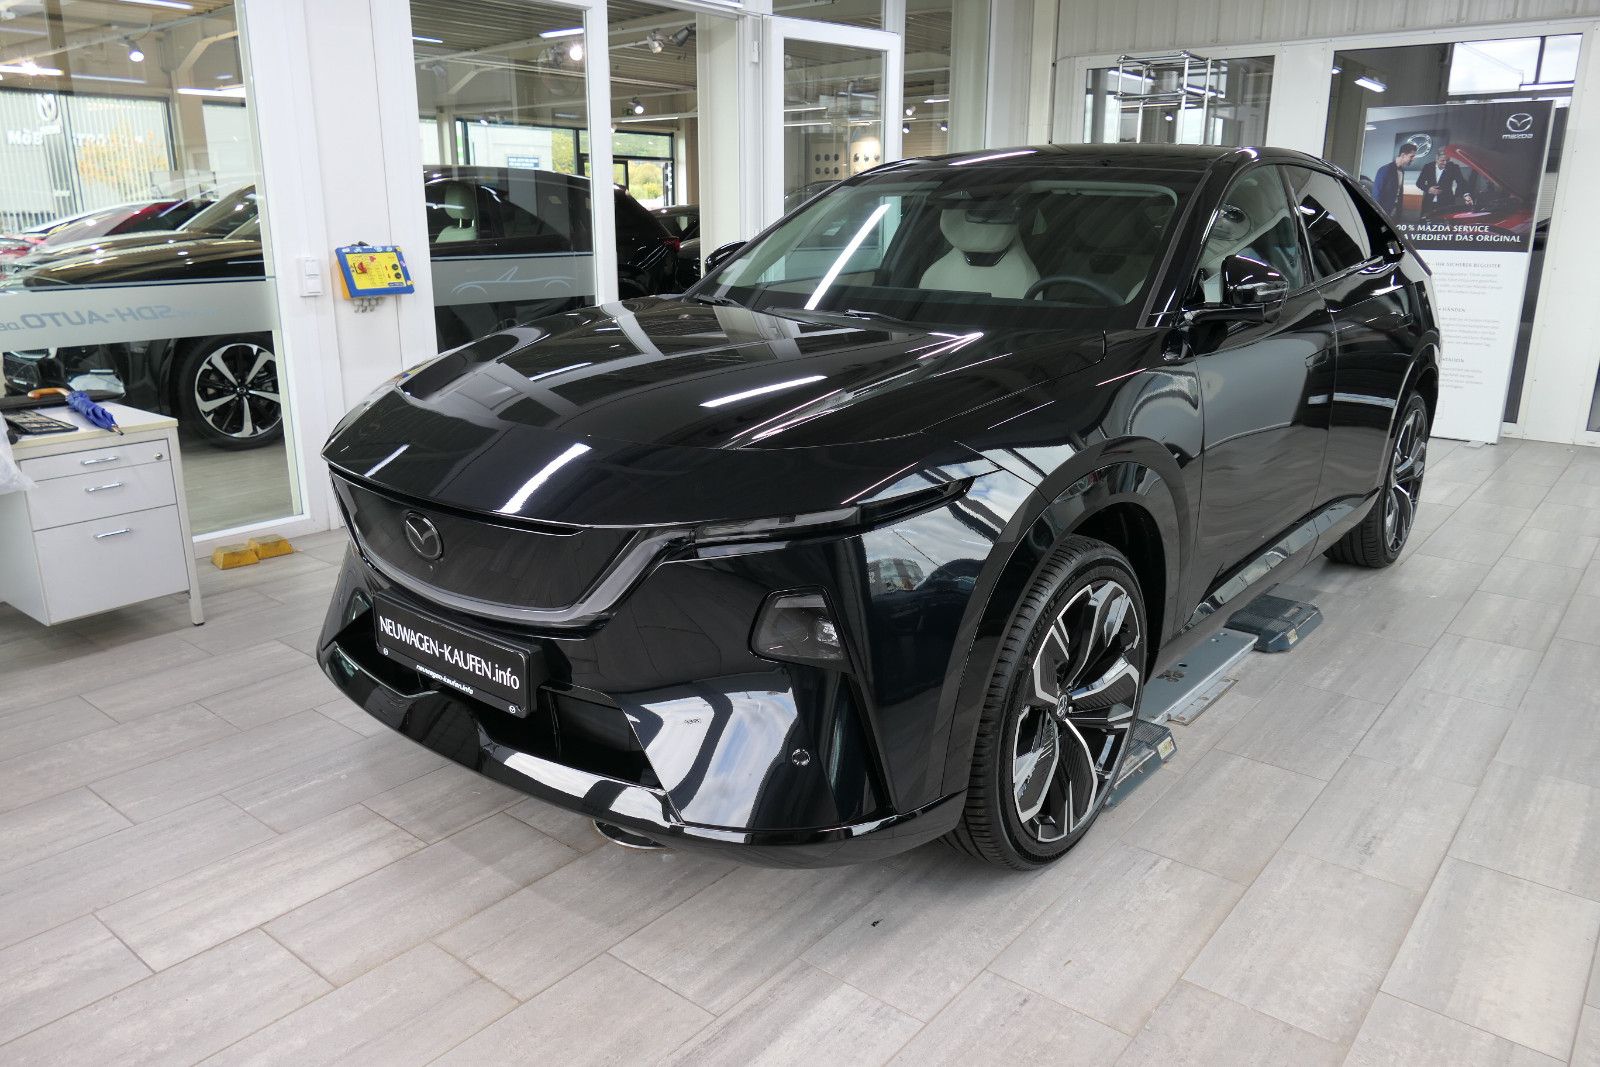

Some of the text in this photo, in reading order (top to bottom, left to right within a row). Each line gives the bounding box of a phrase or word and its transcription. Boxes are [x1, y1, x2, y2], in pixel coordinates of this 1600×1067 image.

[1417, 224, 1451, 233] MAZDA
[1453, 225, 1490, 233] SERVICE
[1411, 233, 1453, 241] VERDIENT
[1455, 233, 1474, 242] DAS
[1476, 234, 1521, 243] ORIGINAL
[379, 615, 520, 690] NEUWAGEN-KAUFEN.info
